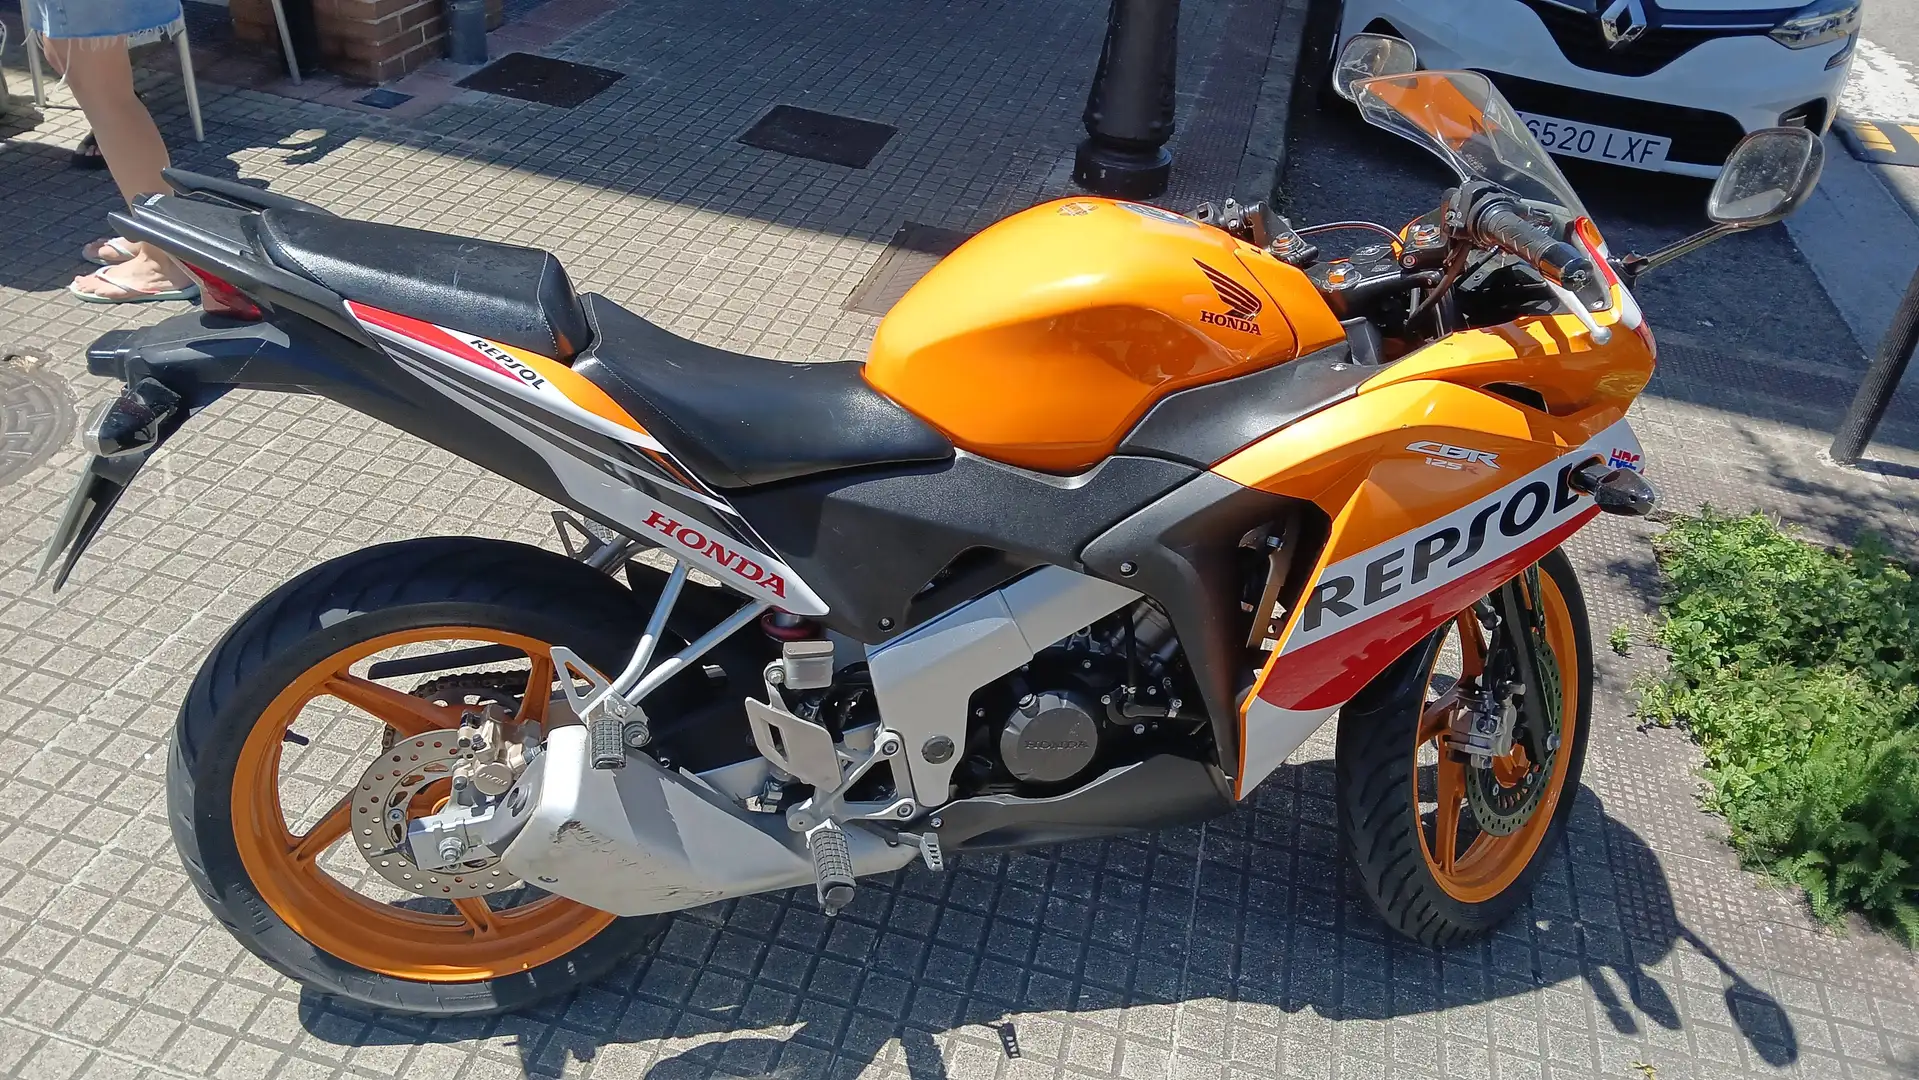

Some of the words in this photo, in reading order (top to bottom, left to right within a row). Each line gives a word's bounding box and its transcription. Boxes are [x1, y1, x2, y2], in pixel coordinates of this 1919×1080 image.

[1526, 119, 1595, 153] 6520
[1602, 133, 1661, 163] LXF
[1199, 310, 1262, 335] HONDA
[470, 339, 546, 390] REPSOL
[1405, 440, 1501, 470] CBR
[642, 510, 787, 599] HONDA
[1303, 462, 1580, 632] REPSOL
[1024, 740, 1090, 751] HONDA
